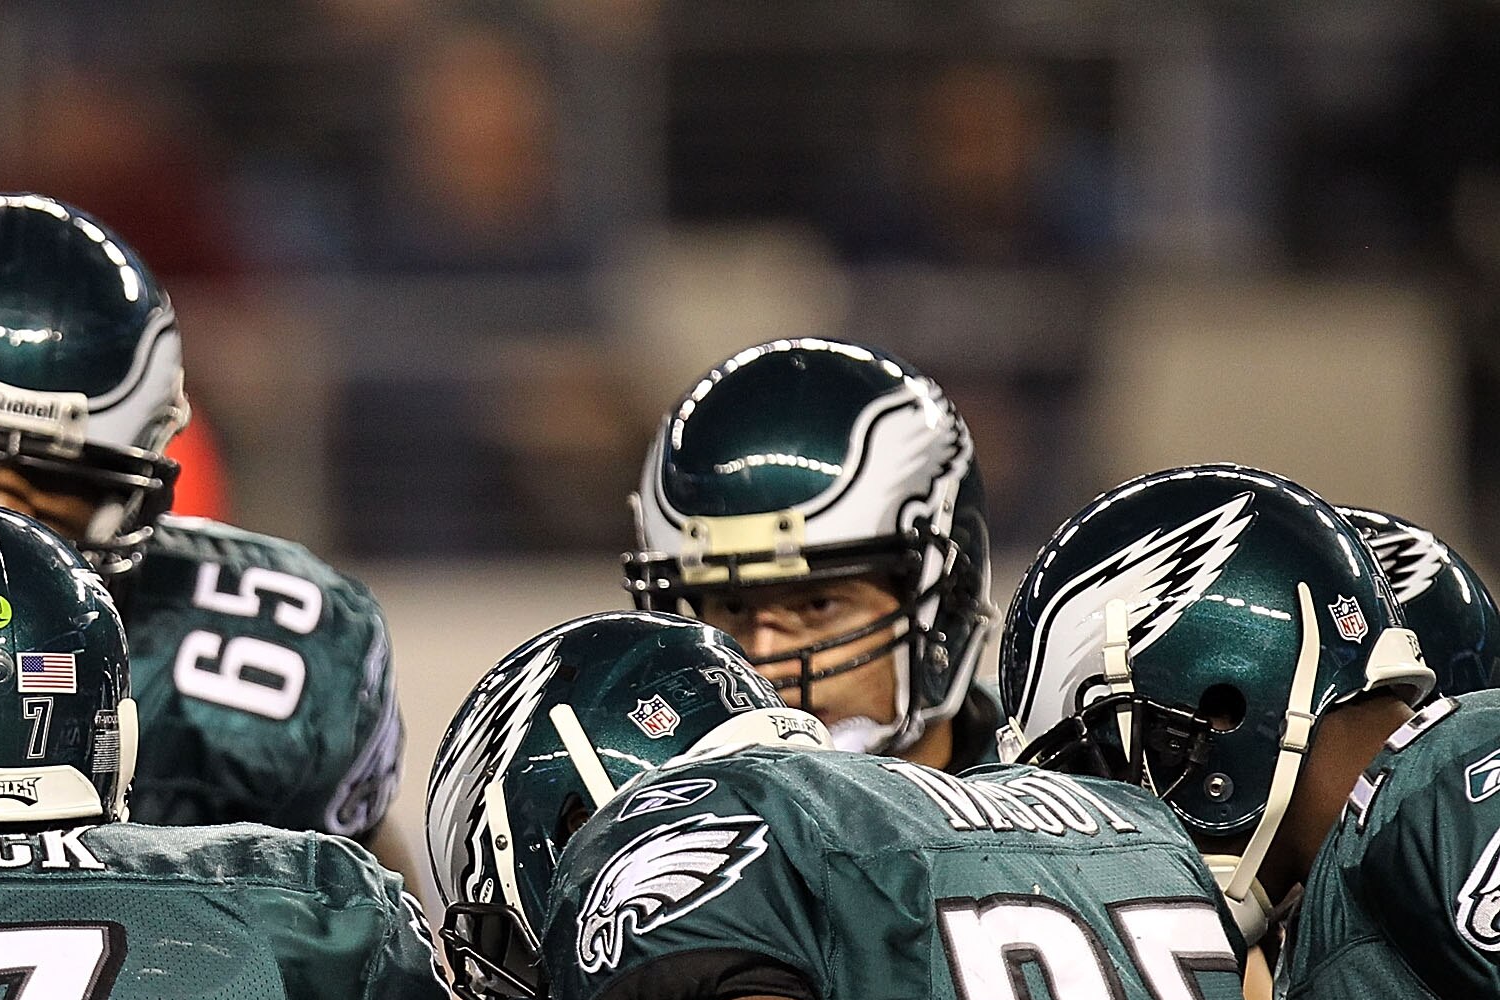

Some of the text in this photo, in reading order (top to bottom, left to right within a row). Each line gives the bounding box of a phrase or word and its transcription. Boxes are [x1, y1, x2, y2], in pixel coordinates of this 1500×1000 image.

[174, 561, 323, 720] 65
[1340, 614, 1364, 634] NFL
[22, 696, 54, 760] 7
[644, 710, 675, 734] NFL
